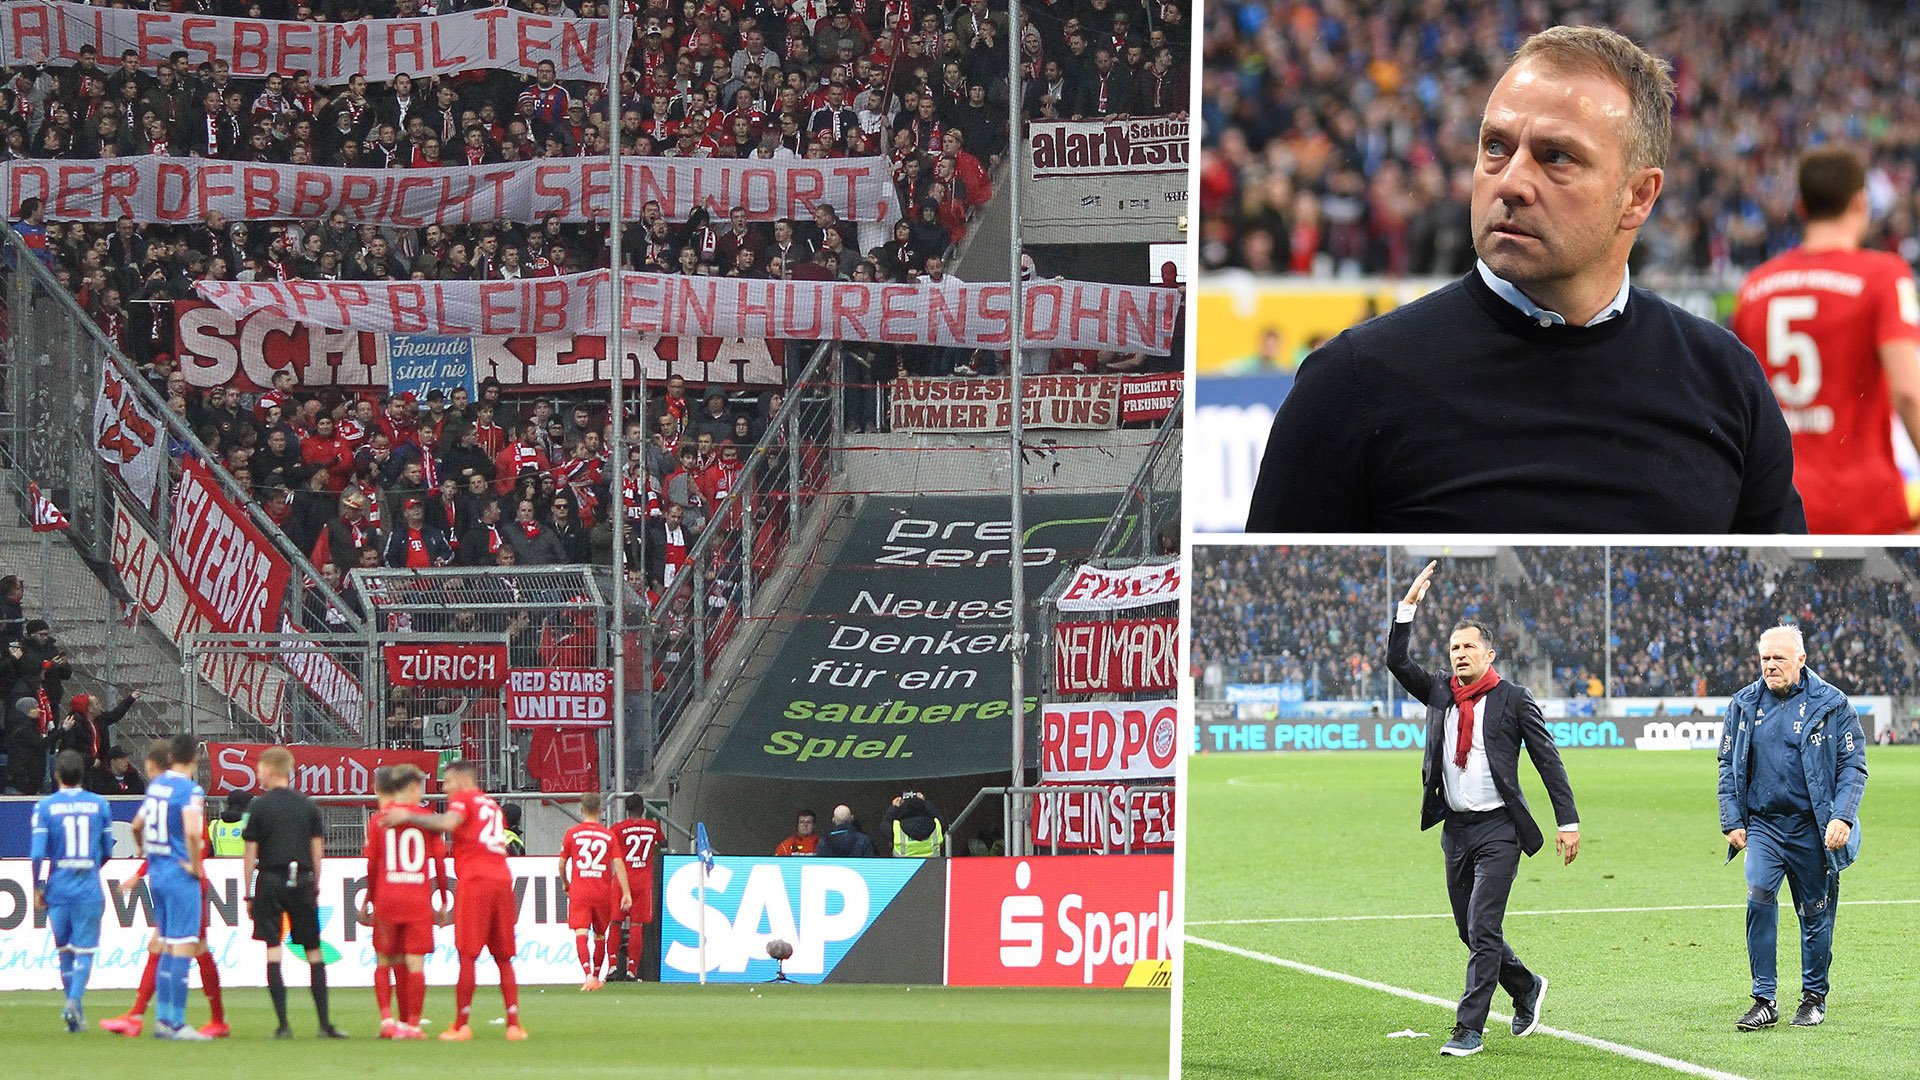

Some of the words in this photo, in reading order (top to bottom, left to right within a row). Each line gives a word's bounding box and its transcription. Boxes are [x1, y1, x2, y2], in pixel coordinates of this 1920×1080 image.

[12, 5, 217, 72] ALLES
[232, 20, 368, 79] BEIM
[9, 164, 140, 220] DER
[156, 163, 280, 219] DFB
[290, 171, 515, 226] BRICHT
[534, 163, 676, 220] SEIN
[387, 269, 609, 335] BLEIBT
[622, 271, 714, 333] EIN
[737, 279, 1181, 349] HURENSOHN!
[393, 335, 468, 357] Freunde
[1766, 295, 1823, 408] 5
[396, 360, 437, 380] sind
[440, 358, 467, 378] nie
[893, 403, 988, 428] IMMER
[996, 400, 1042, 428] BEI
[1050, 399, 1111, 426] UNS
[886, 518, 1012, 543] pre
[112, 508, 169, 613] BAD
[848, 590, 1013, 621] Neues
[828, 625, 1030, 655] Denken
[399, 650, 495, 681] ZÜRICH
[808, 660, 887, 689] für
[898, 663, 977, 690] ein
[511, 672, 545, 693] RED
[549, 671, 606, 693] STARS
[514, 695, 607, 719] UNITED
[783, 696, 1038, 724] sauberes
[763, 730, 914, 762] Spiel.
[1043, 709, 1116, 773] RED
[1209, 723, 1267, 751] THE
[1274, 722, 1368, 751] PRICE.
[1375, 722, 1426, 749] LOV
[63, 815, 90, 857] 11
[385, 827, 425, 873] 10
[625, 834, 654, 862] 27
[576, 837, 608, 871] 32
[665, 863, 870, 974] SAP
